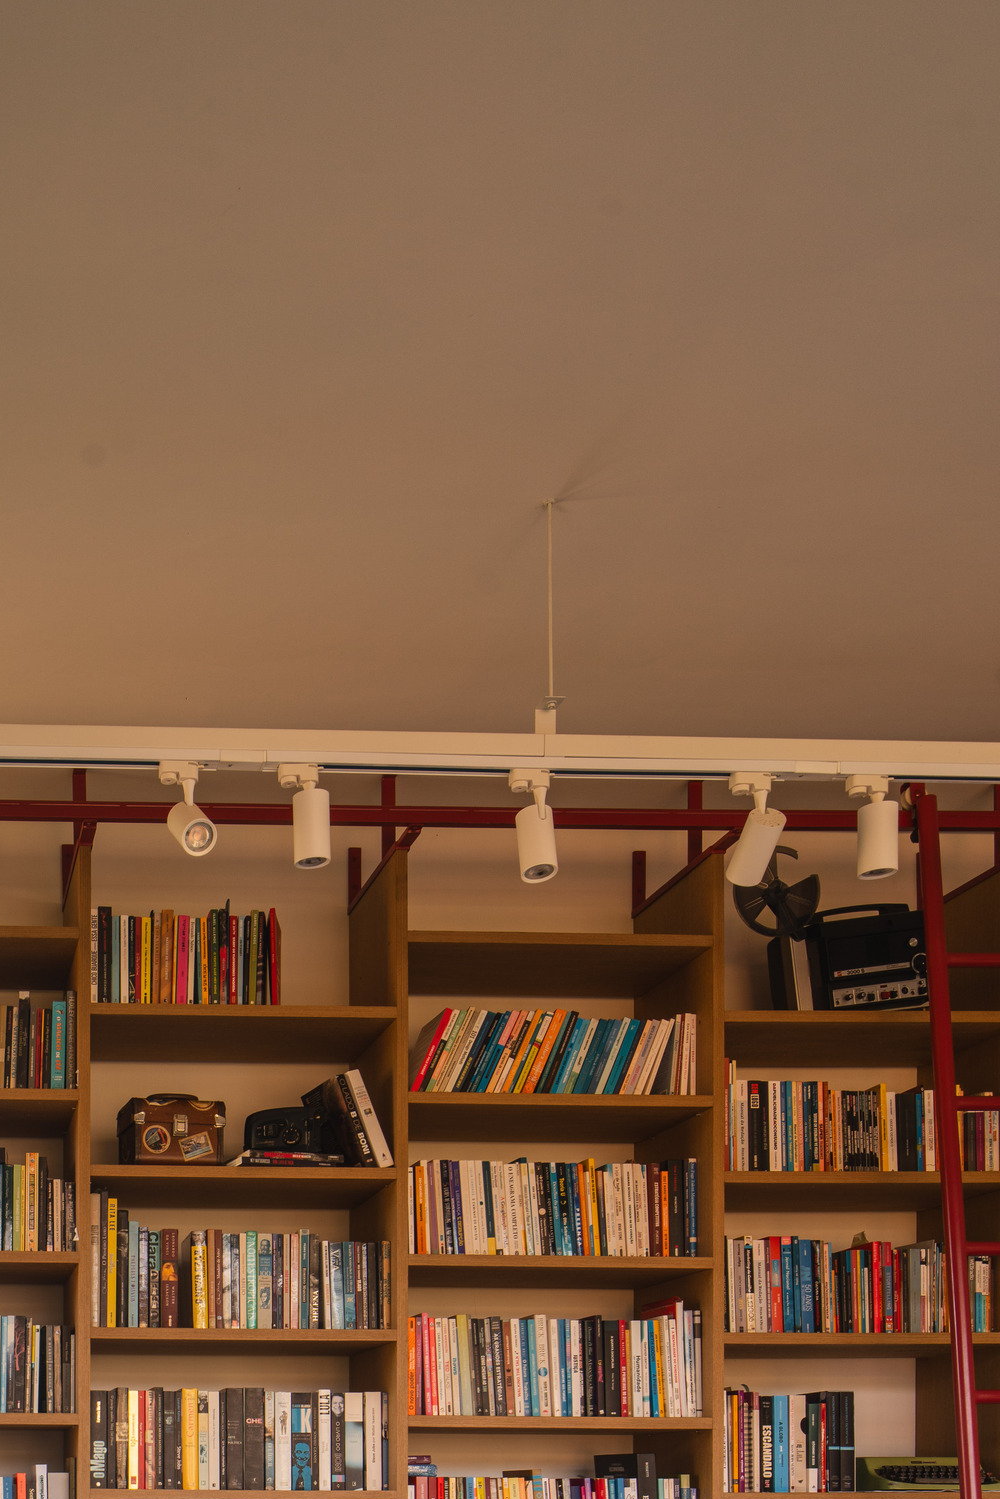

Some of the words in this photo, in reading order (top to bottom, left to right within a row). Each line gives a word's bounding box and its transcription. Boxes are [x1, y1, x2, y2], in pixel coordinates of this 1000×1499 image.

[55, 1022, 63, 1051] MÁGICO
[55, 1060, 63, 1070] OZ
[341, 1087, 355, 1111] LADO
[350, 1110, 358, 1119] B
[357, 1131, 371, 1156] BONI
[508, 1172, 517, 1208] ENEAGRAMA
[149, 1232, 158, 1270] Clara
[804, 1284, 811, 1293] 50
[312, 1290, 320, 1322] HELENA
[495, 1365, 503, 1401] ESTRATÉGIAS
[186, 1402, 194, 1438] Carmen
[246, 1417, 263, 1425] CHE
[301, 1408, 312, 1433] K
[320, 1394, 330, 1415] LULA
[90, 1440, 107, 1478] oMago
[762, 1425, 772, 1478] ESCÂNDALO
